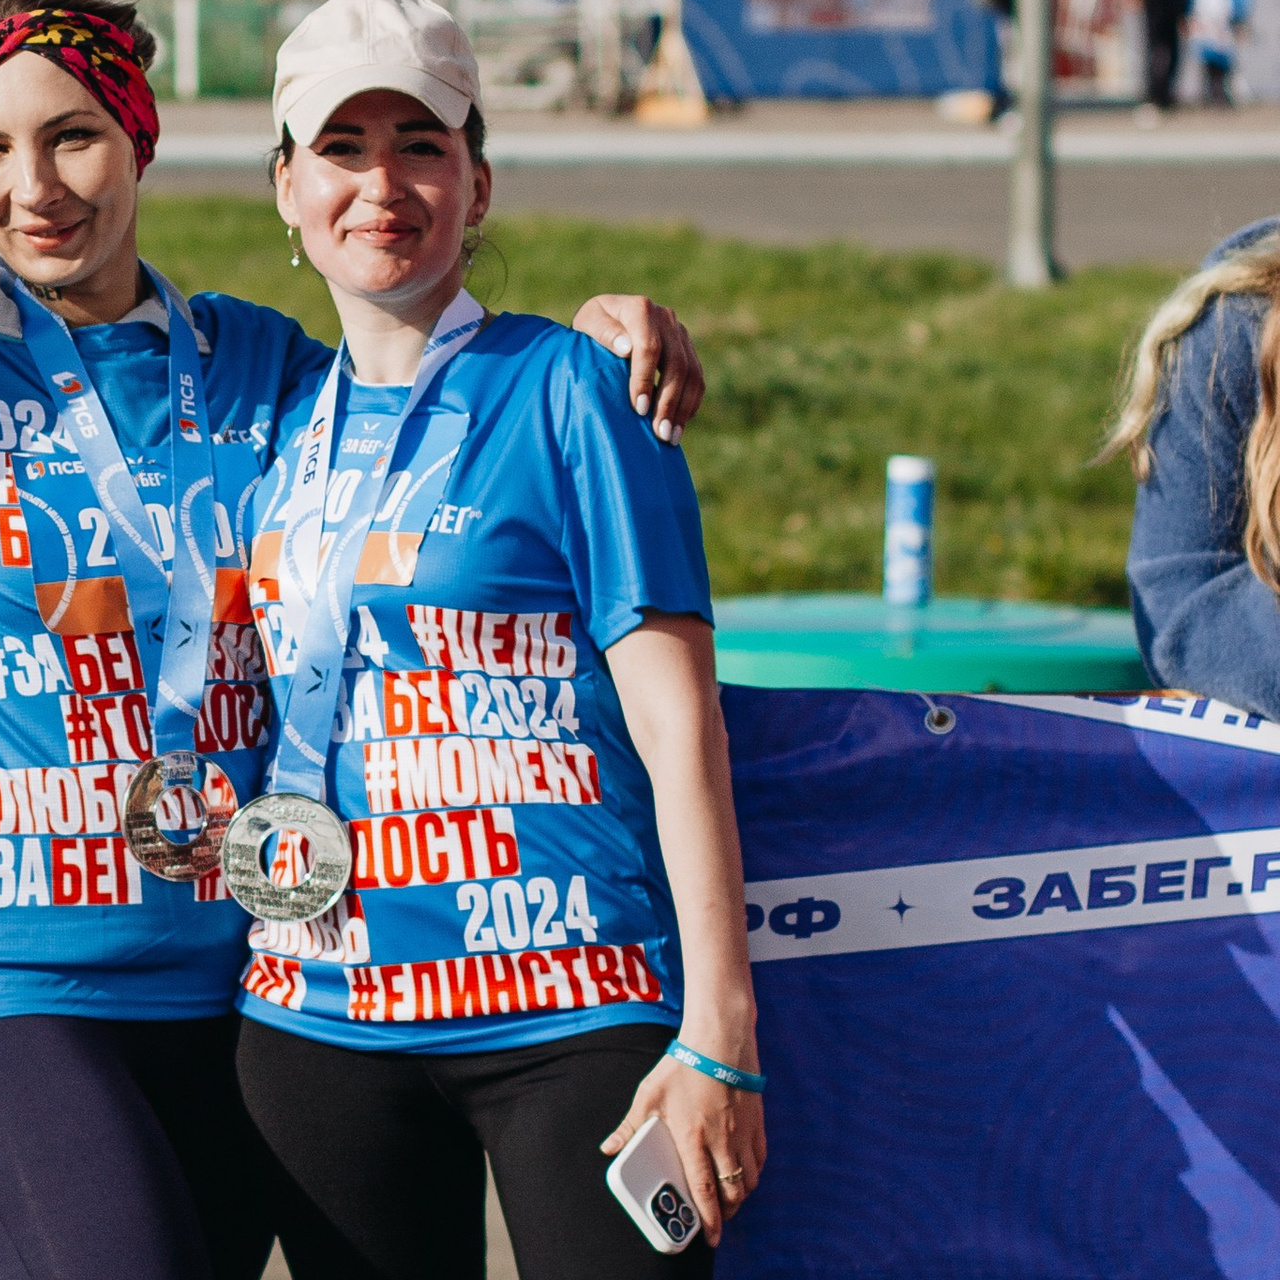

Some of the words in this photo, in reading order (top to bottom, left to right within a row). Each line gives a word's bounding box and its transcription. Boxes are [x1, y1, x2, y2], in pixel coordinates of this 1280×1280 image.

[179, 372, 196, 416] ПСБ
[67, 396, 99, 439] ПСБ
[48, 461, 86, 476] ПСБ
[303, 441, 321, 486] ПСБ
[456, 875, 599, 953] 2024
